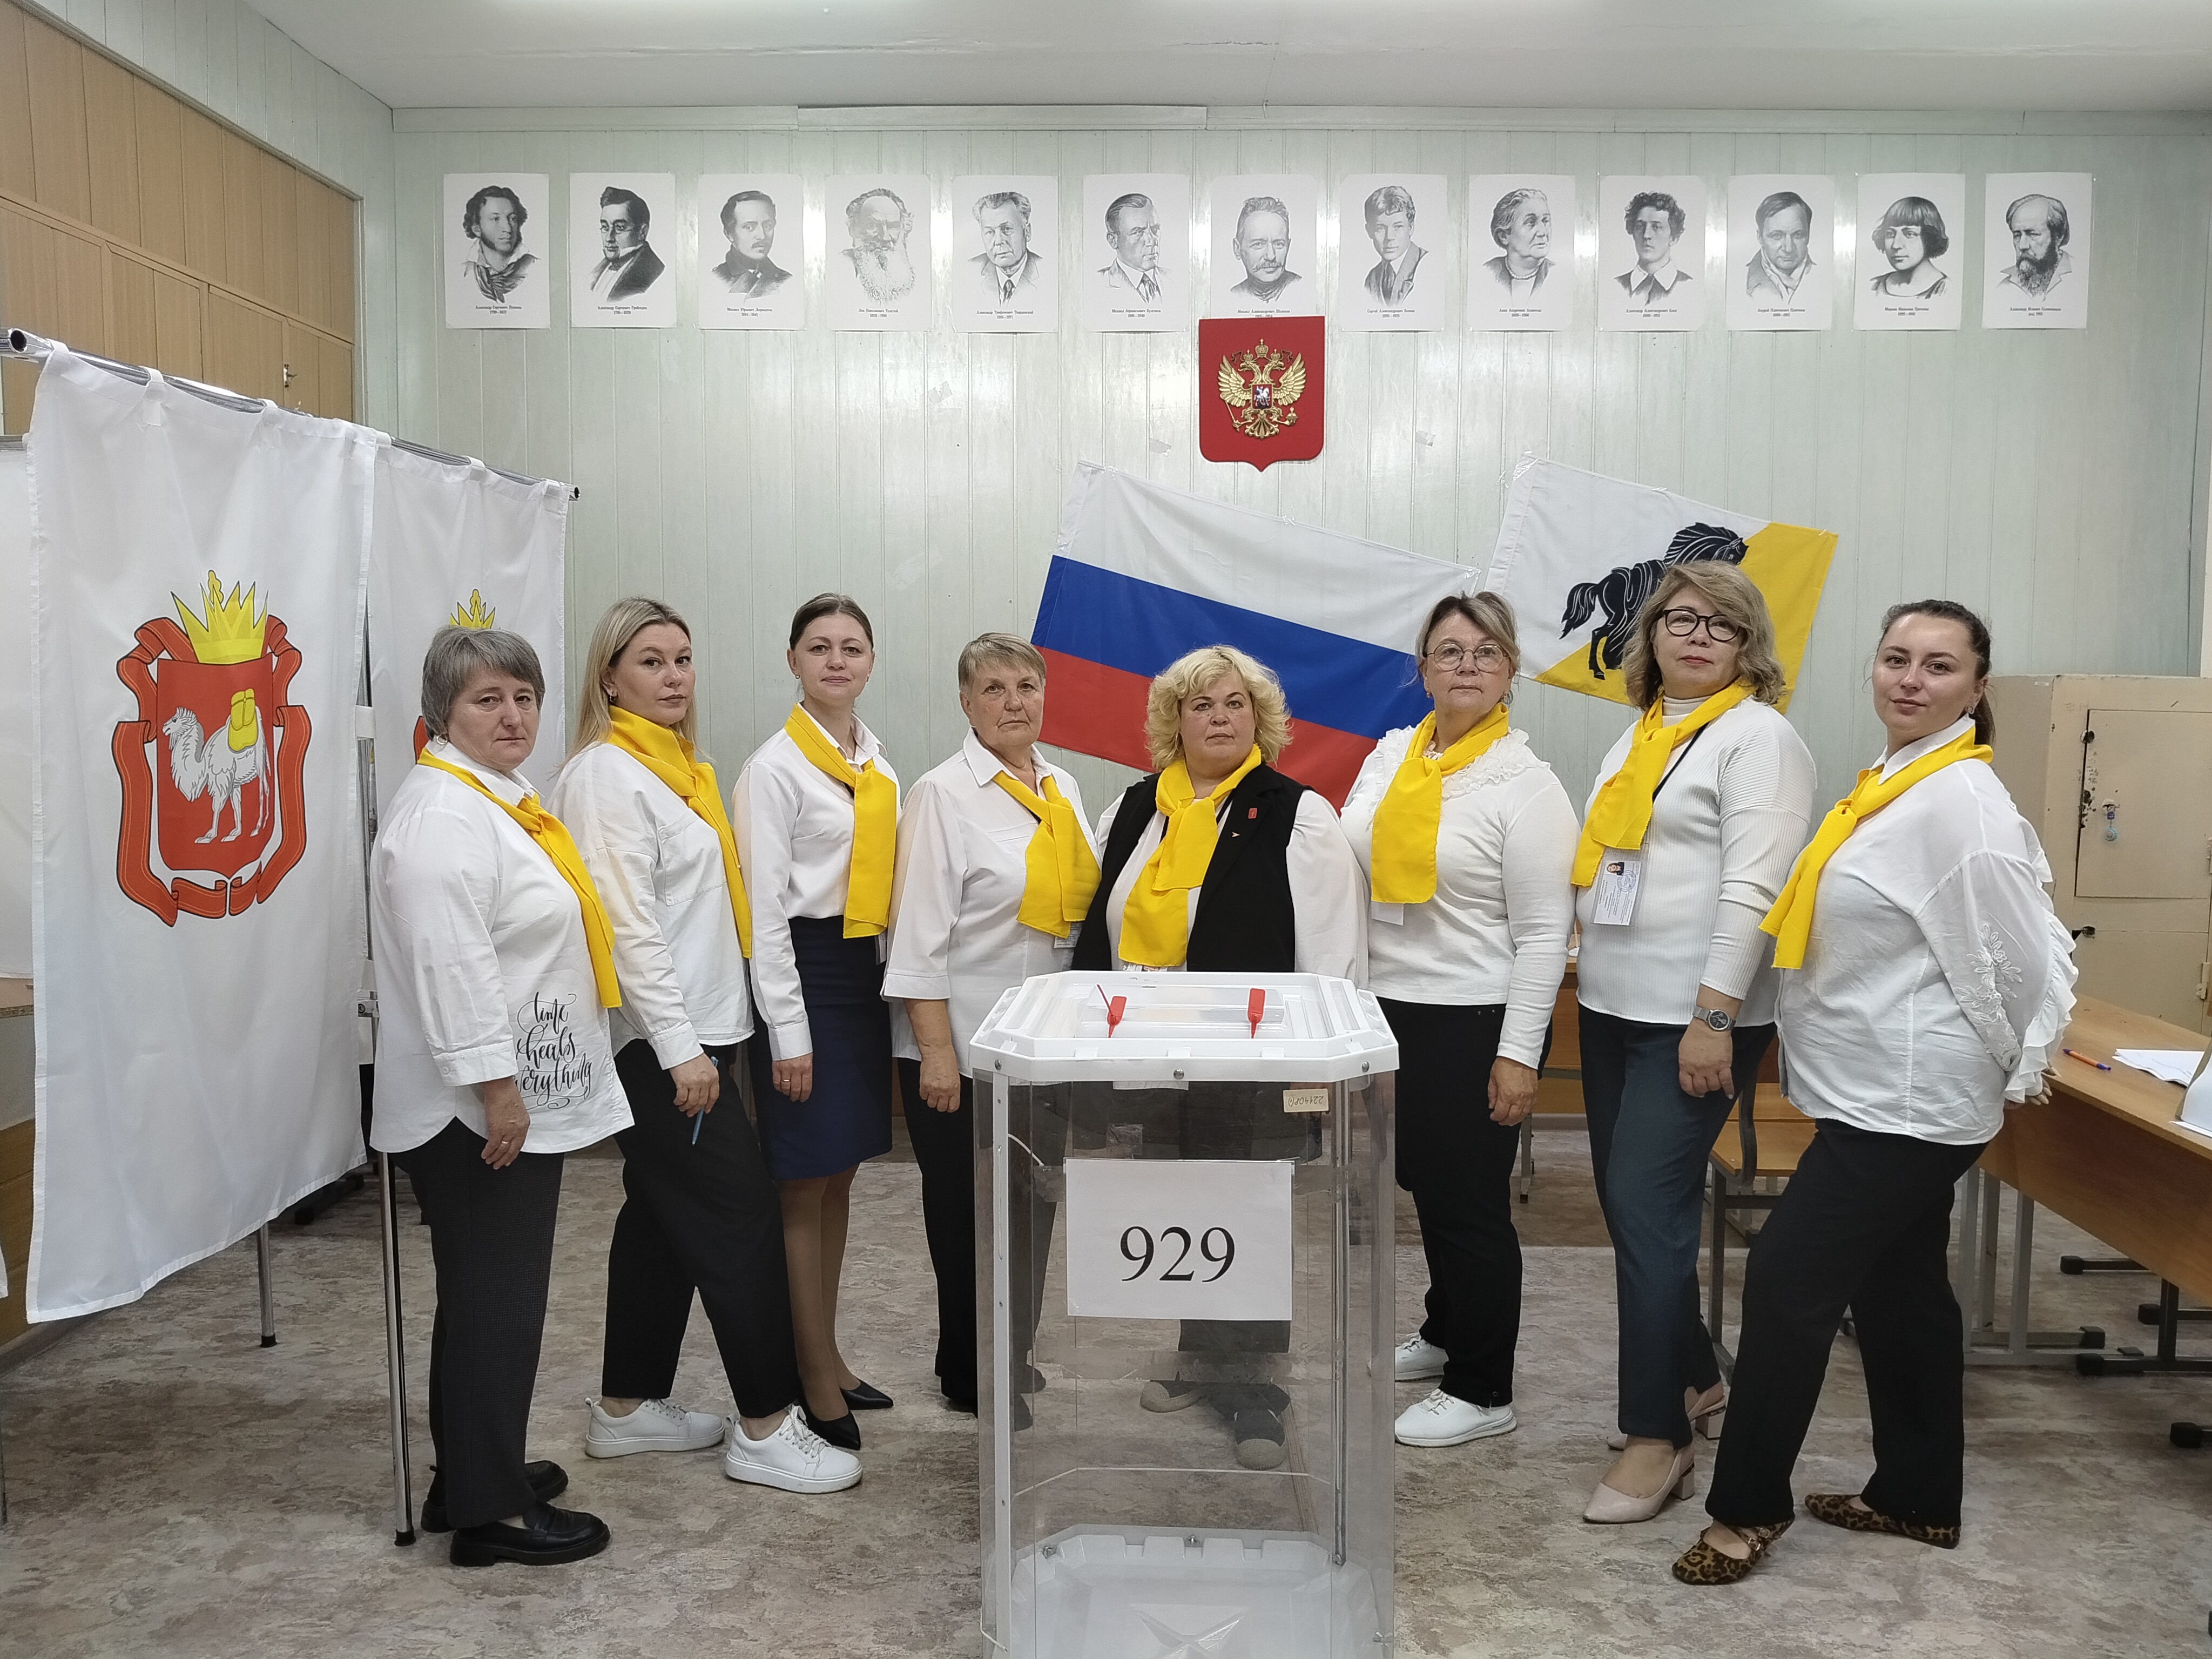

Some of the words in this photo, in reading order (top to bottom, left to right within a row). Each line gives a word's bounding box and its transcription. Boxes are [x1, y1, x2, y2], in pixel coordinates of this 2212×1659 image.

[517, 992, 576, 1034] time
[516, 1023, 575, 1069] heals
[1120, 1225, 1236, 1283] 929
